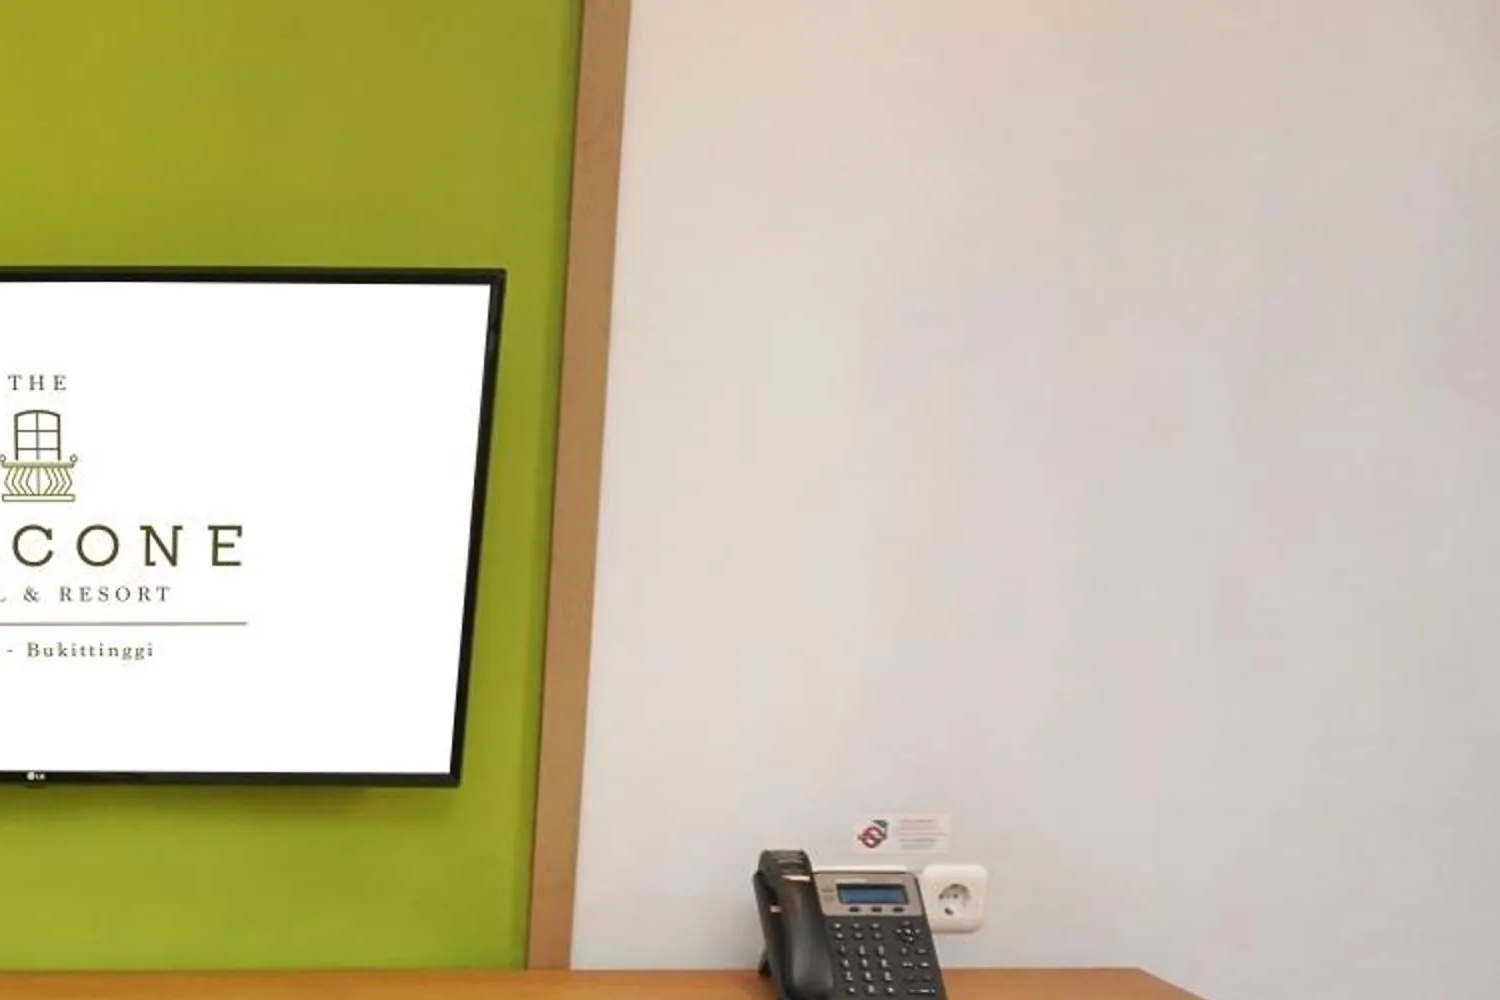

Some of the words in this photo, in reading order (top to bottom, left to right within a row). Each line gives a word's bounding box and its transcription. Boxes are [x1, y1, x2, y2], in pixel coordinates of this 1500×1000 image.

[7, 374, 67, 391] THE
[23, 586, 39, 603] &
[59, 585, 171, 603] RESORT
[27, 641, 154, 660] Bukittinggi
